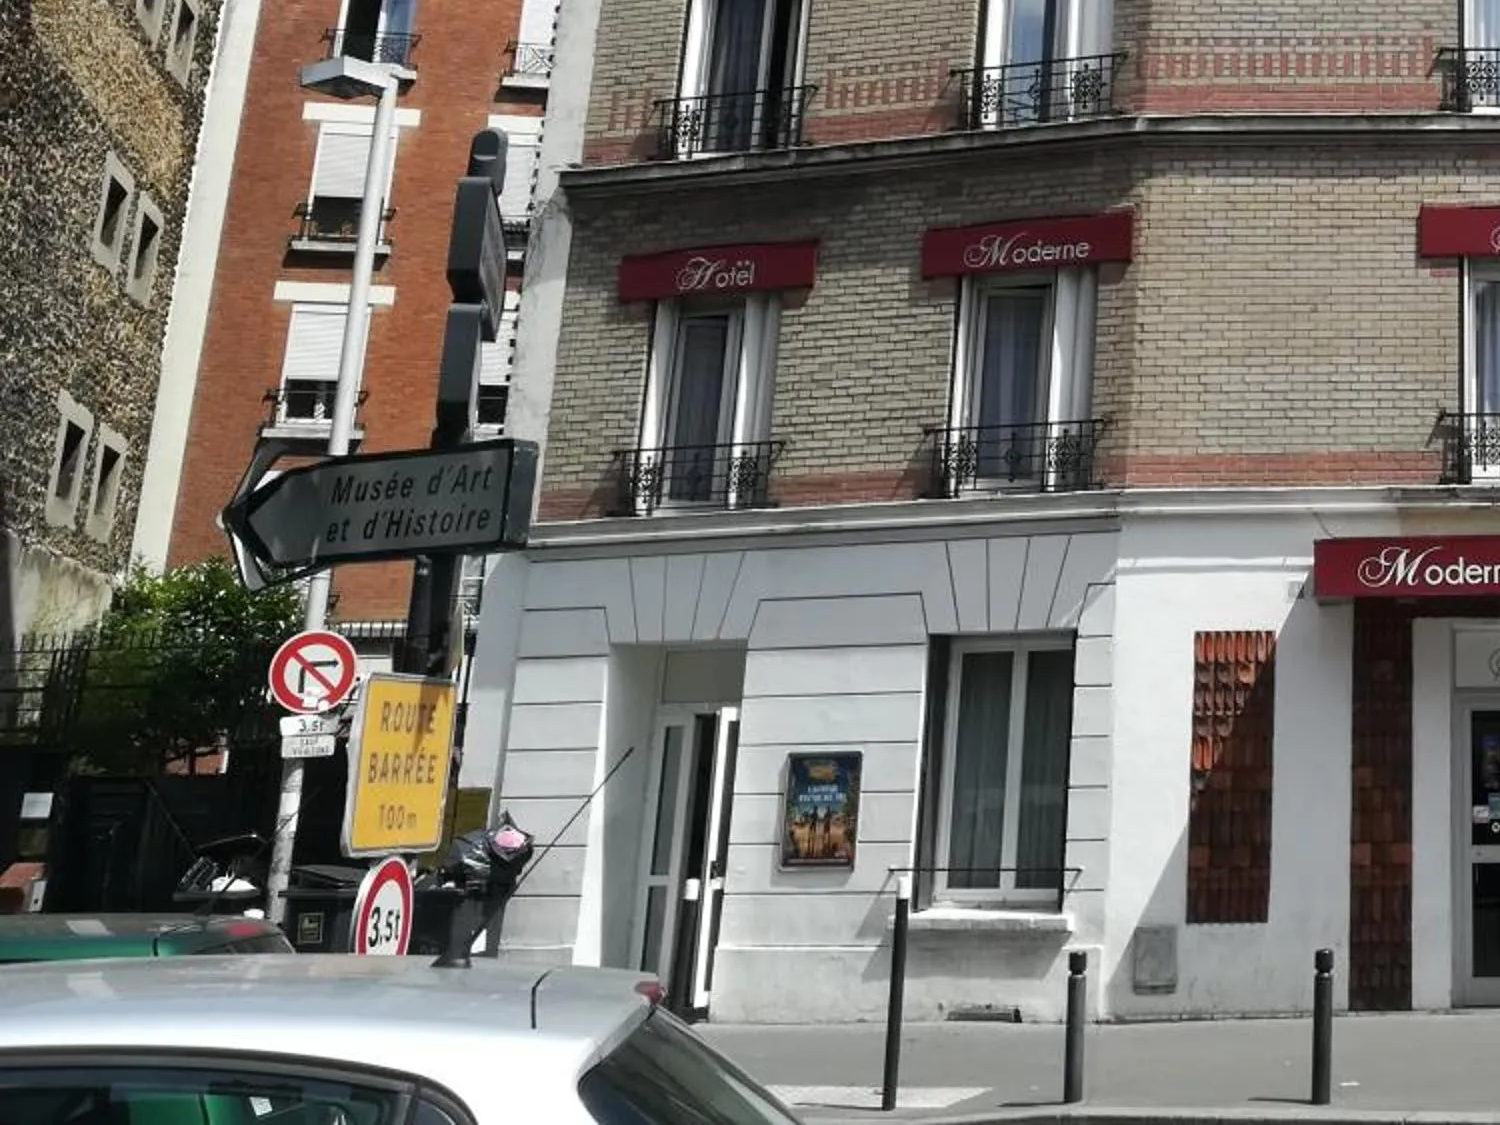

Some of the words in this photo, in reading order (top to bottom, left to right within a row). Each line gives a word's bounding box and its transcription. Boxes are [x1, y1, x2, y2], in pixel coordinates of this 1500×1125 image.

[963, 231, 1091, 268] Moderne
[331, 471, 415, 504] Musée
[427, 464, 493, 496] d'Art
[327, 518, 350, 543] et
[363, 503, 491, 541] d'Histoire
[380, 700, 437, 734] ROUTE
[367, 747, 438, 785] BARRÉE
